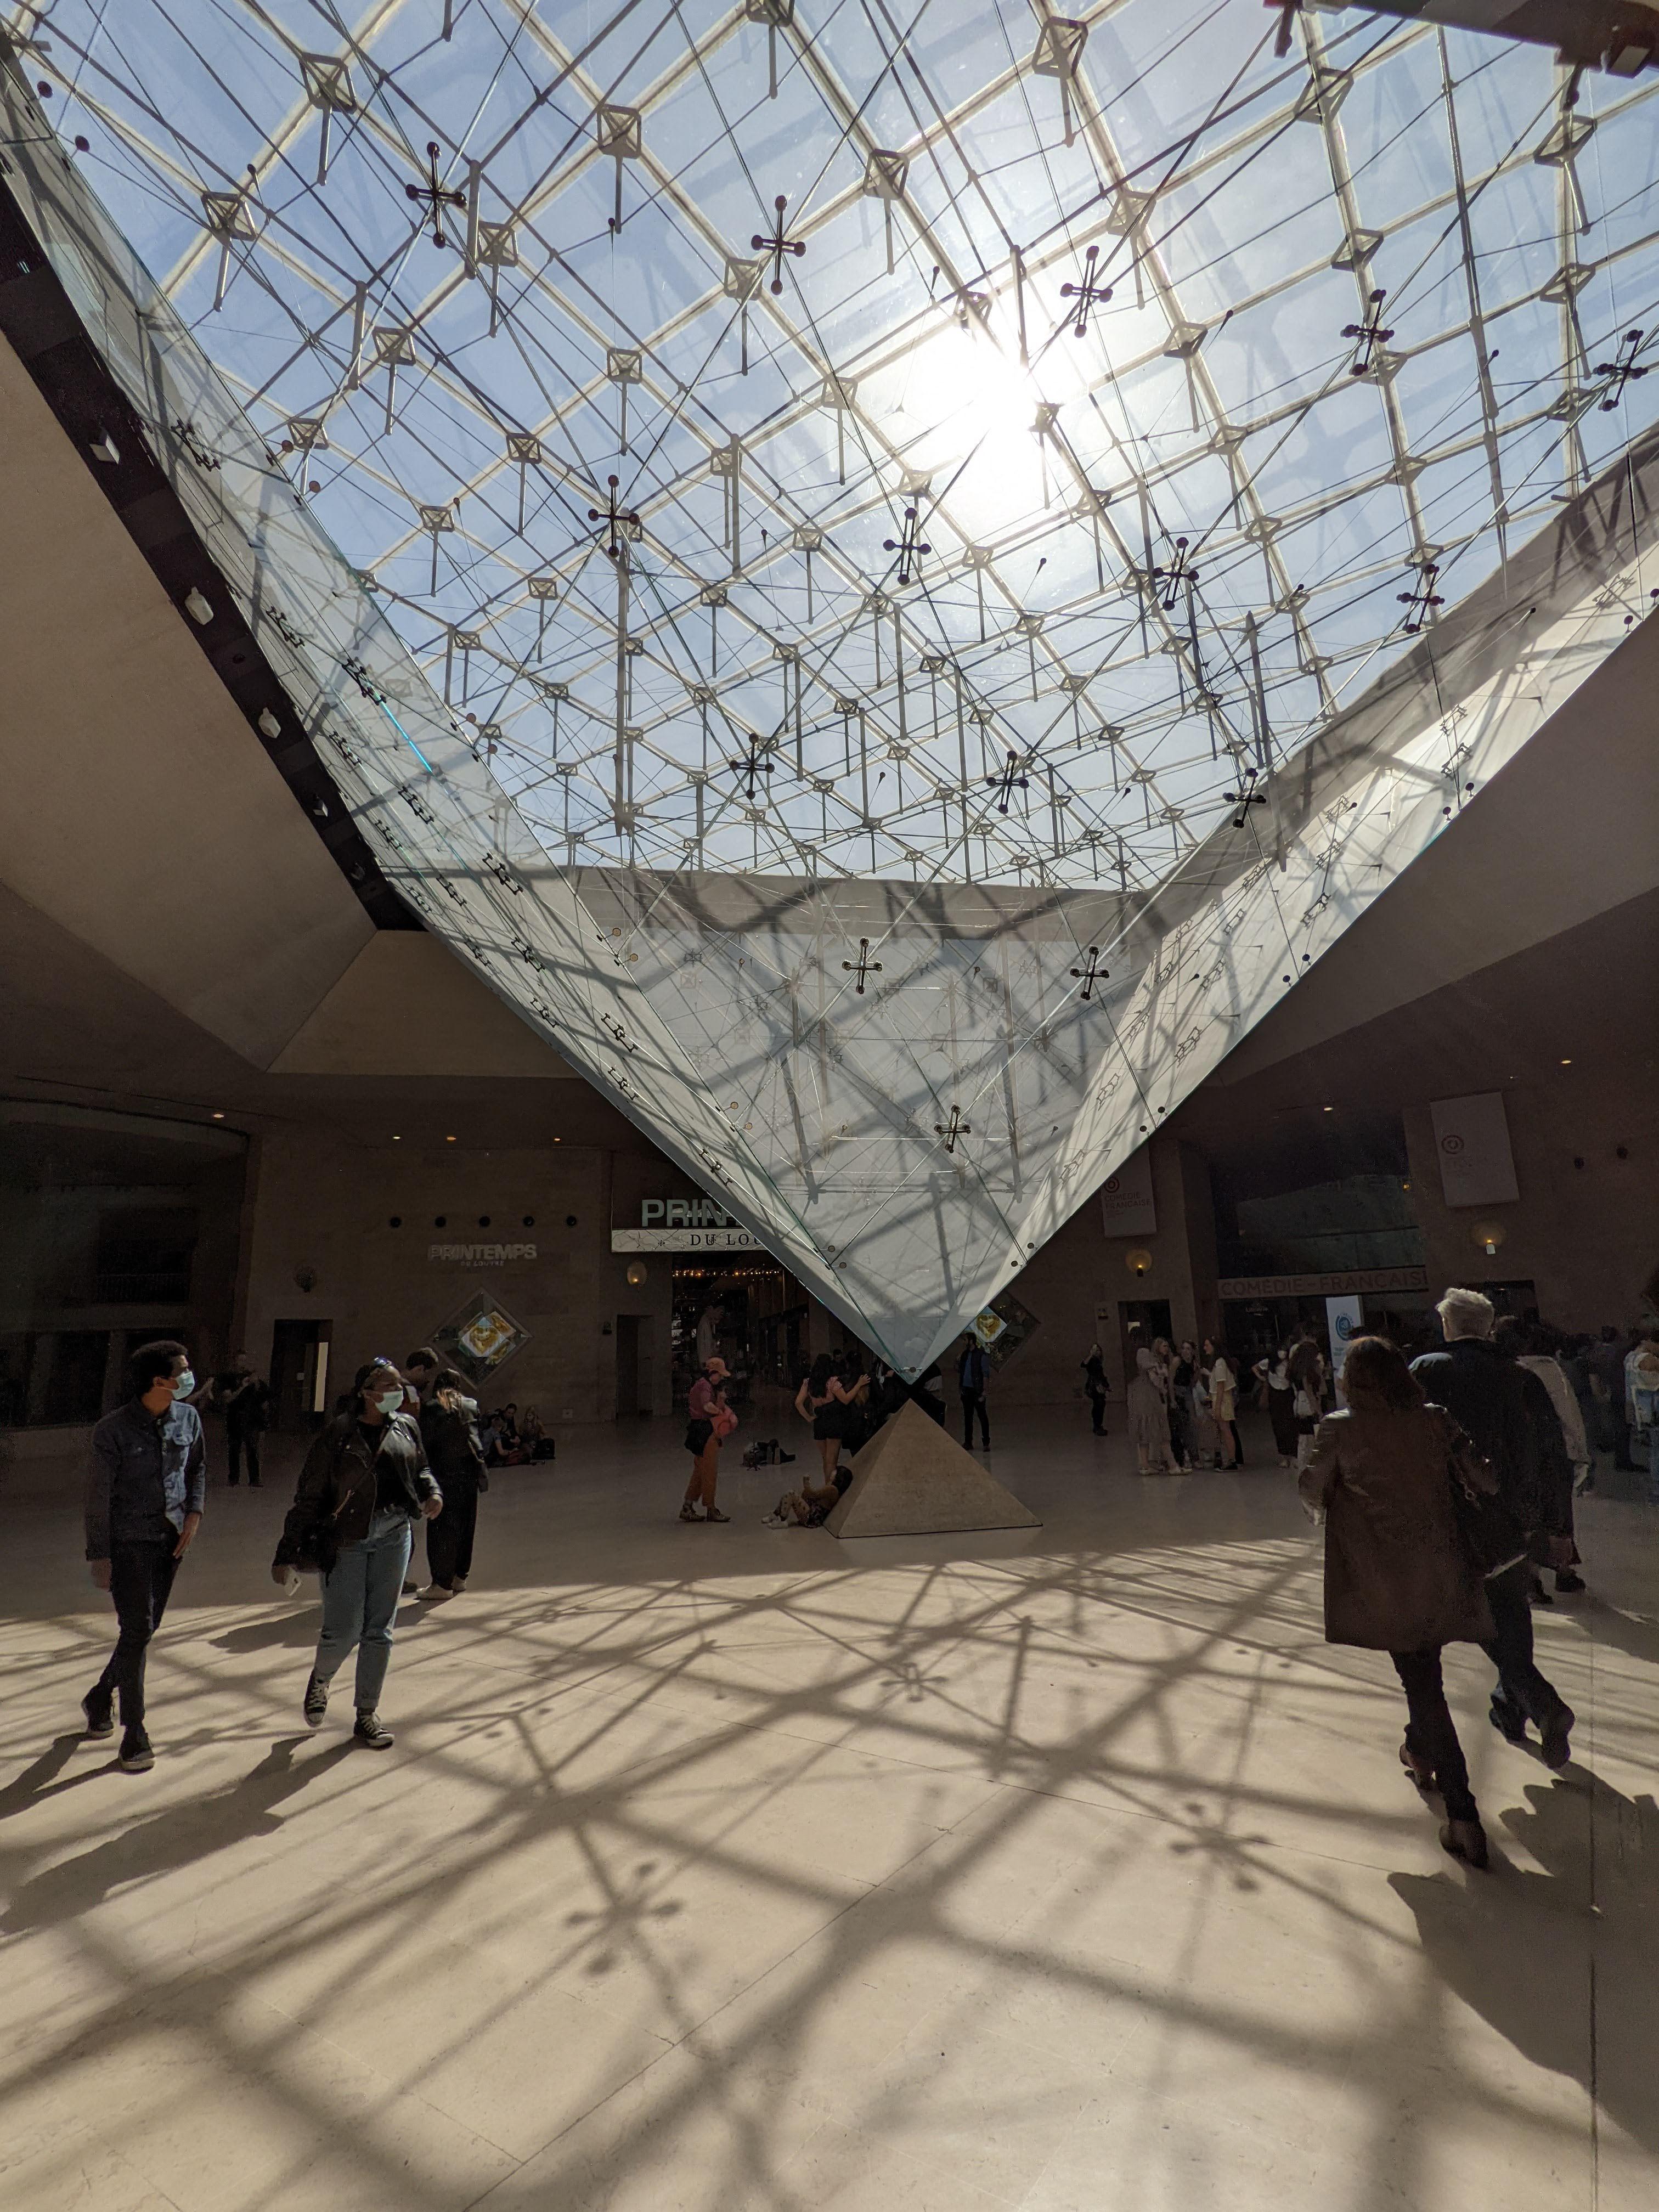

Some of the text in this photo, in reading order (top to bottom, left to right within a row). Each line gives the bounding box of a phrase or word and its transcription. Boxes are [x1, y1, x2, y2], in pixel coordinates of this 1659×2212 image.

[642, 1199, 742, 1227] PRIN
[690, 1234, 716, 1246] DU
[428, 1244, 537, 1260] PRINTEMPS
